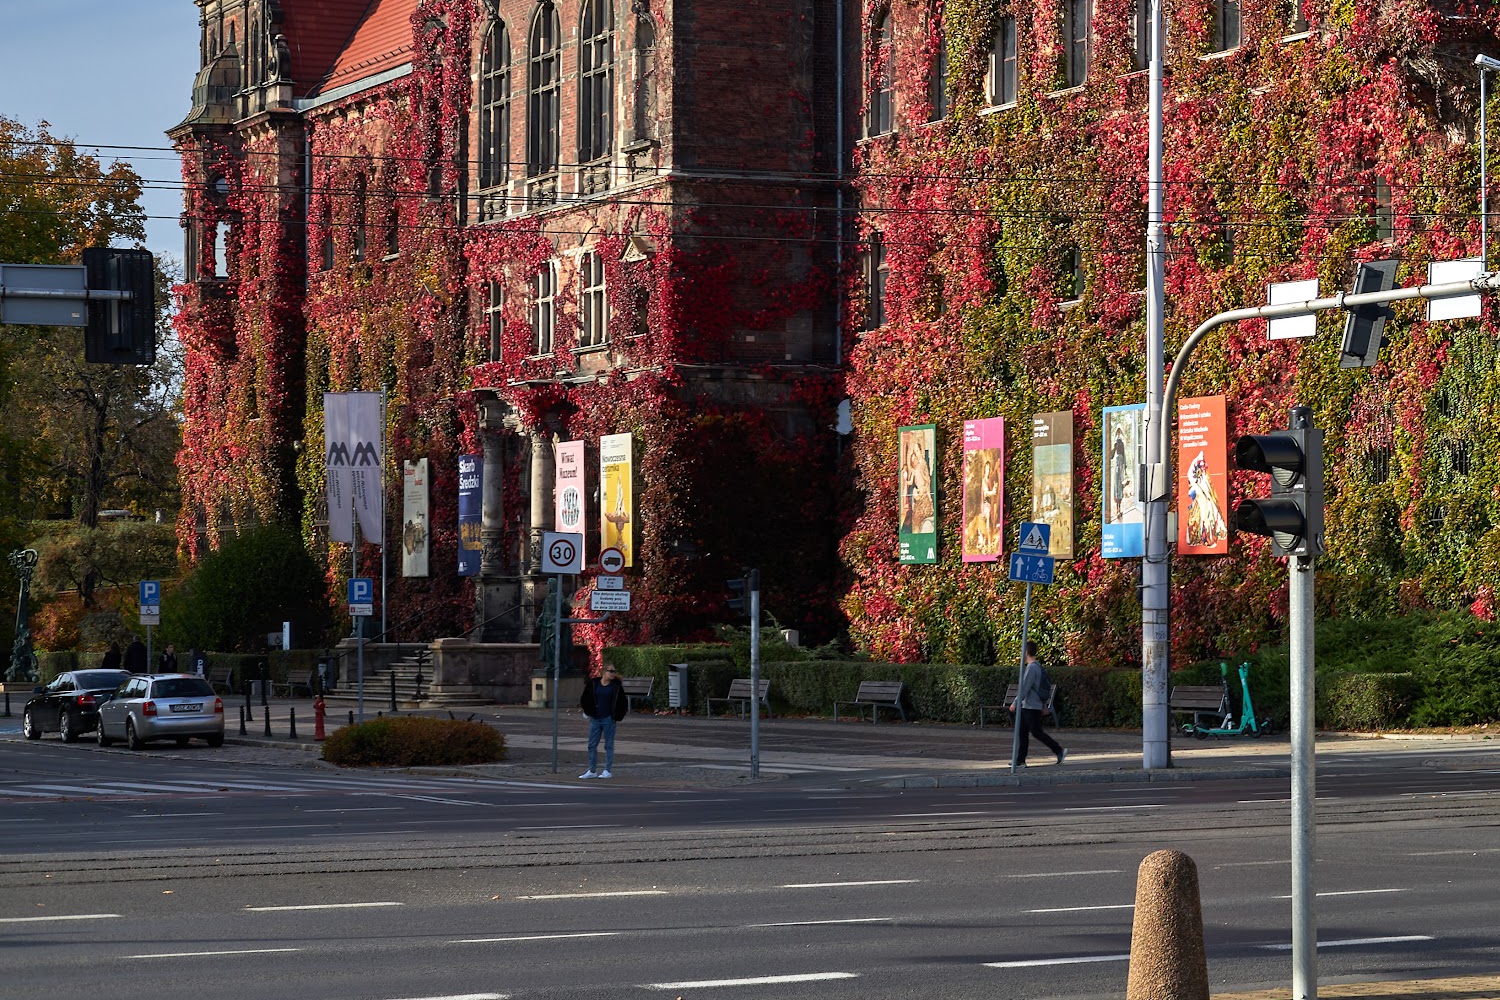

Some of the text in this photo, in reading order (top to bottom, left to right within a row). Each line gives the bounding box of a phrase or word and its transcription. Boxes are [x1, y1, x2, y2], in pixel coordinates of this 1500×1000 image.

[459, 459, 475, 473] Skarb
[459, 474, 479, 489] Średzki
[553, 547, 572, 560] 30
[144, 583, 155, 598] P
[354, 582, 367, 600] P
